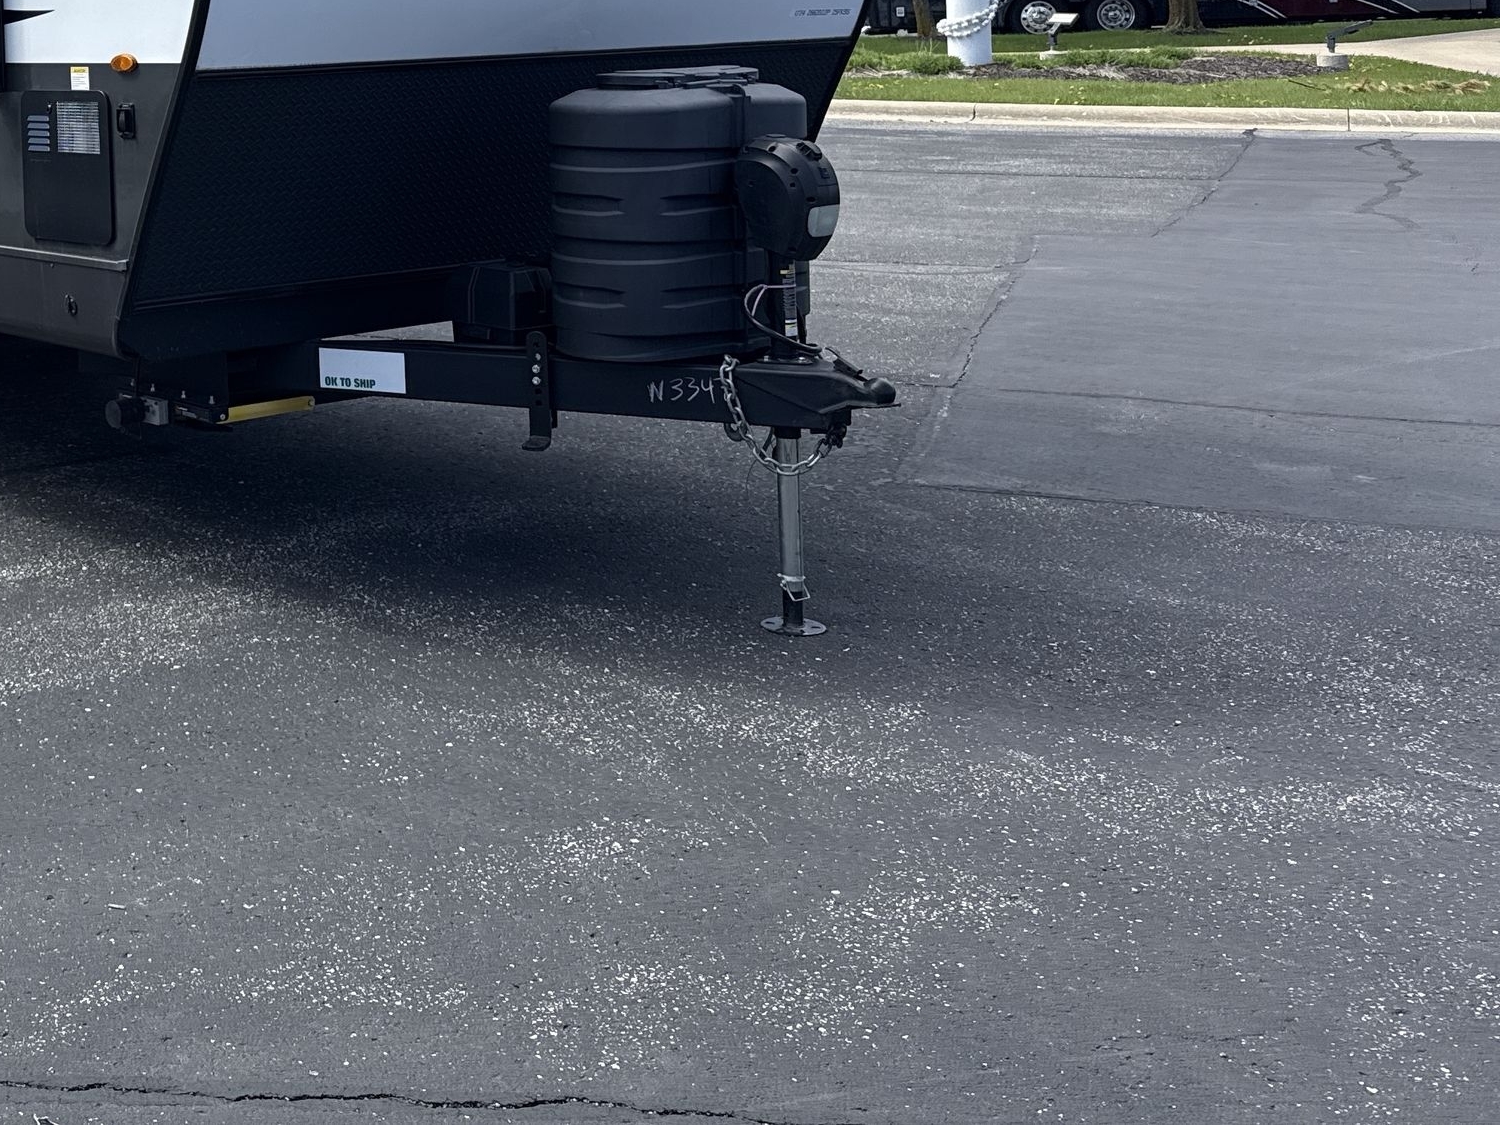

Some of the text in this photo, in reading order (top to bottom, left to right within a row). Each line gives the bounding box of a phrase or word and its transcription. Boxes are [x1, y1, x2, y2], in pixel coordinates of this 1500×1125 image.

[324, 376, 376, 389] OK TO SHIP
[647, 376, 726, 404] N334
